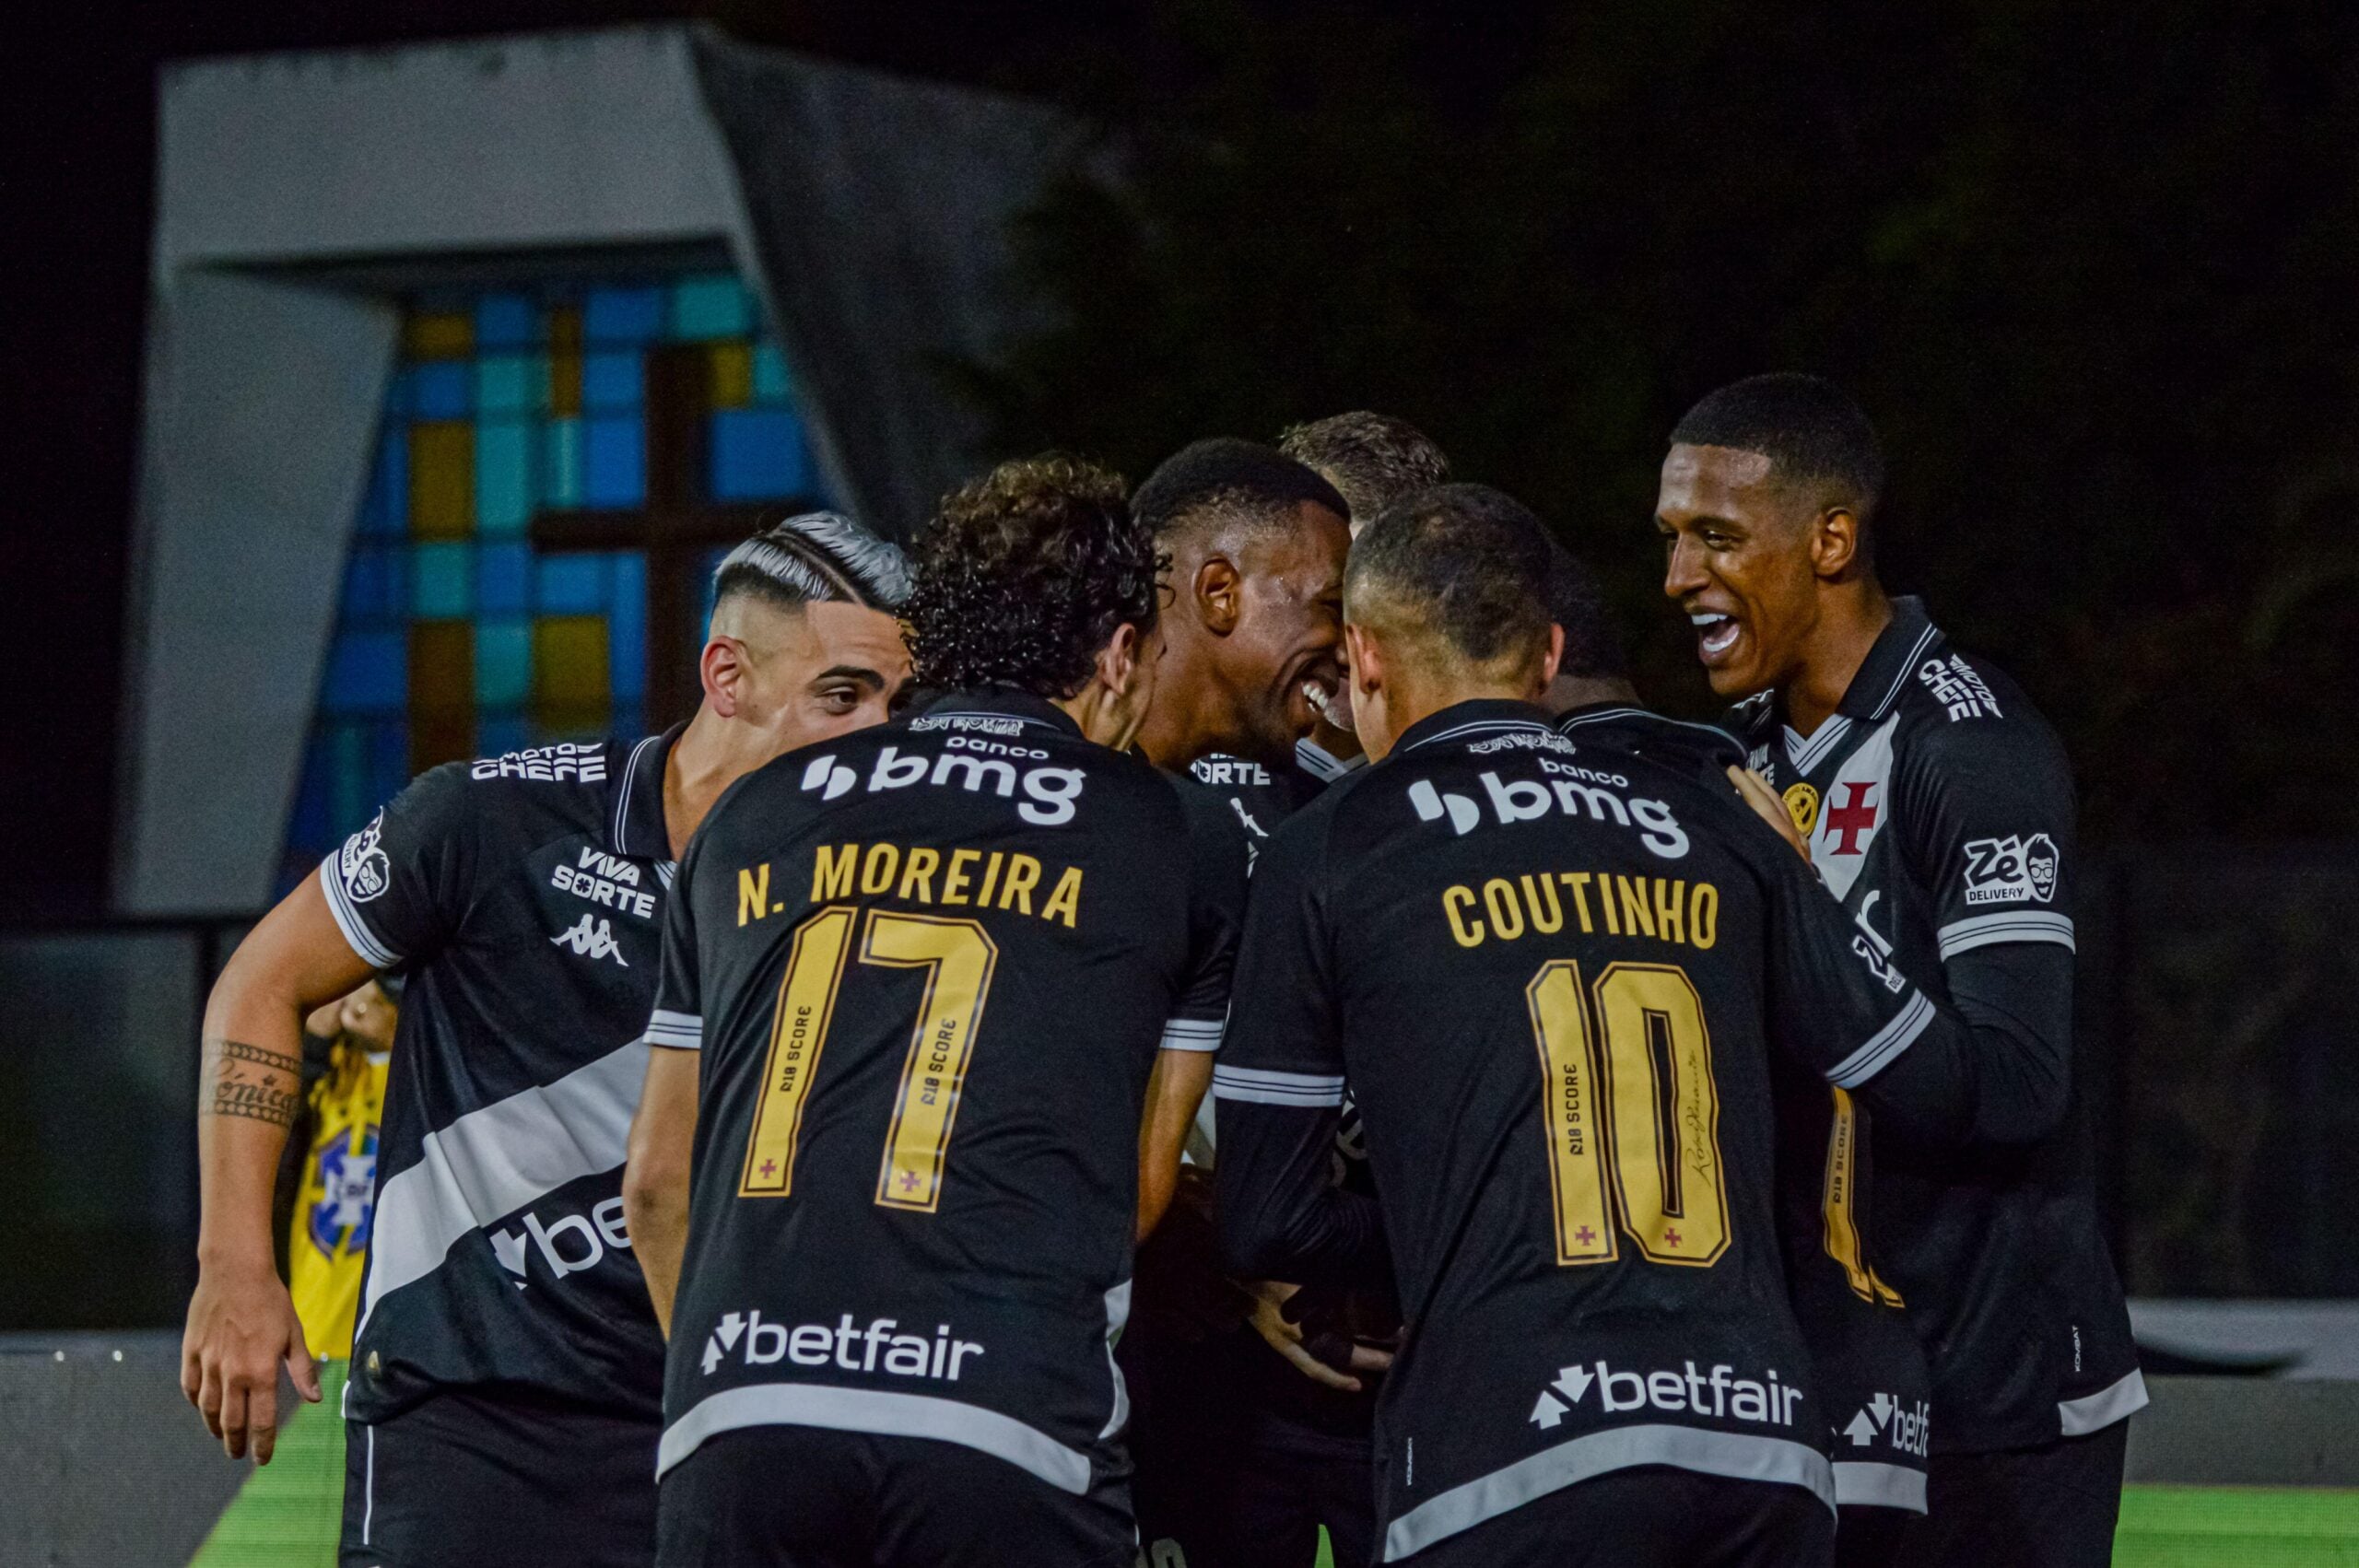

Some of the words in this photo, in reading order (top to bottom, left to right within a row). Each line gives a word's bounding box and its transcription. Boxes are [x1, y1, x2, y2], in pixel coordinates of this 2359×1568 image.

[945, 736, 1050, 760] banco
[1539, 757, 1628, 788] banco
[867, 746, 1086, 825] bmg
[1480, 770, 1690, 859] bmg
[552, 864, 656, 919] SORTE
[578, 846, 640, 886] VIVA
[737, 863, 783, 927] N.
[810, 843, 1084, 929] MOREIRA
[1969, 838, 2025, 887] Zé
[1443, 872, 1719, 949] COUTINHO
[1969, 887, 2025, 902] DELIVERY
[738, 906, 998, 1213] 17
[788, 1006, 812, 1061] SCORE
[930, 1018, 957, 1075] SCORE
[1526, 959, 1731, 1268] 10
[1564, 1063, 1581, 1123] SCORE
[745, 1309, 985, 1381] betfair
[1594, 1361, 1803, 1425] betfair
